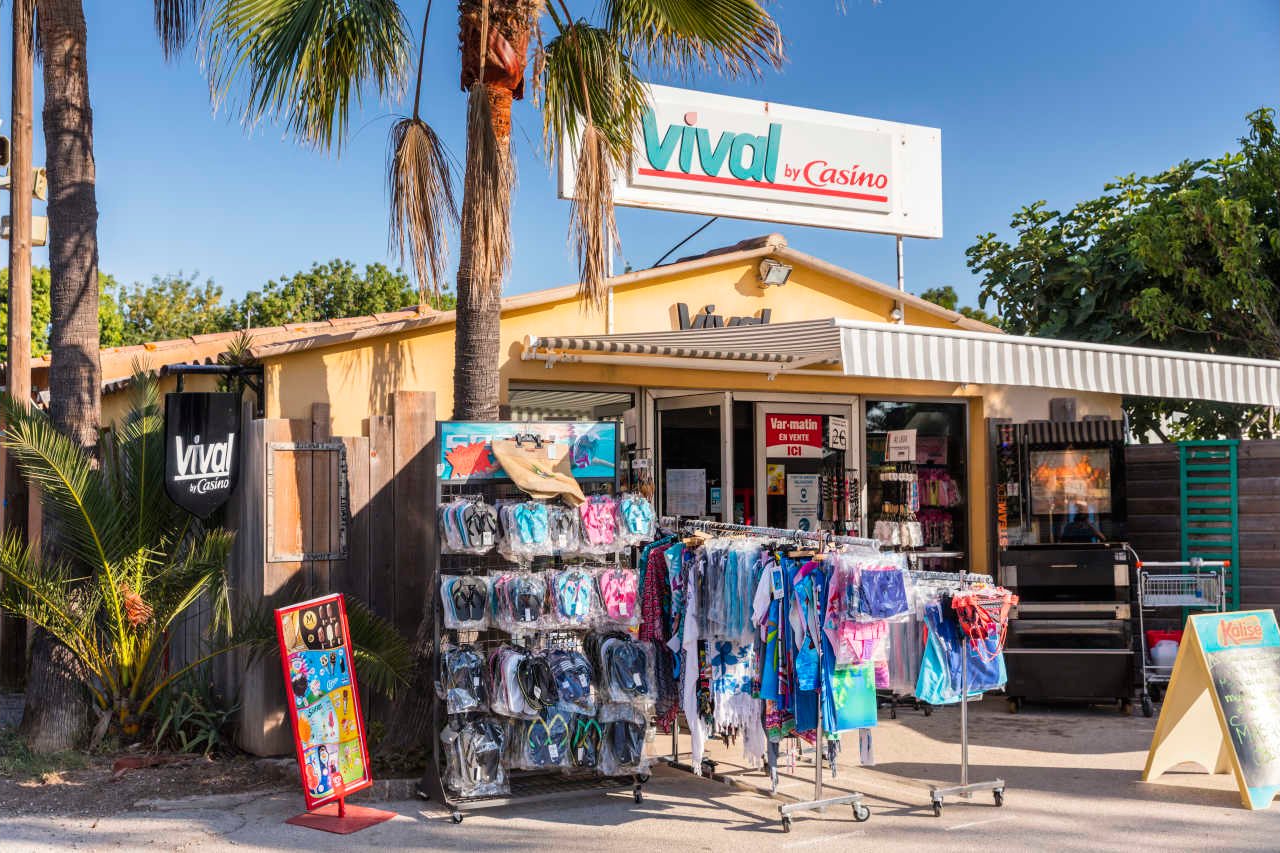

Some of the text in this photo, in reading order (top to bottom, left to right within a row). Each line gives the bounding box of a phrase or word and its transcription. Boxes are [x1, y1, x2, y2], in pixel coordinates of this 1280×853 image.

[641, 105, 888, 189] Vival by Casino
[778, 433, 810, 441] EN VENTE
[176, 433, 235, 476] Vival
[787, 446, 802, 456] ICI
[189, 476, 229, 494] by Casino
[1220, 619, 1263, 646] Kalise
